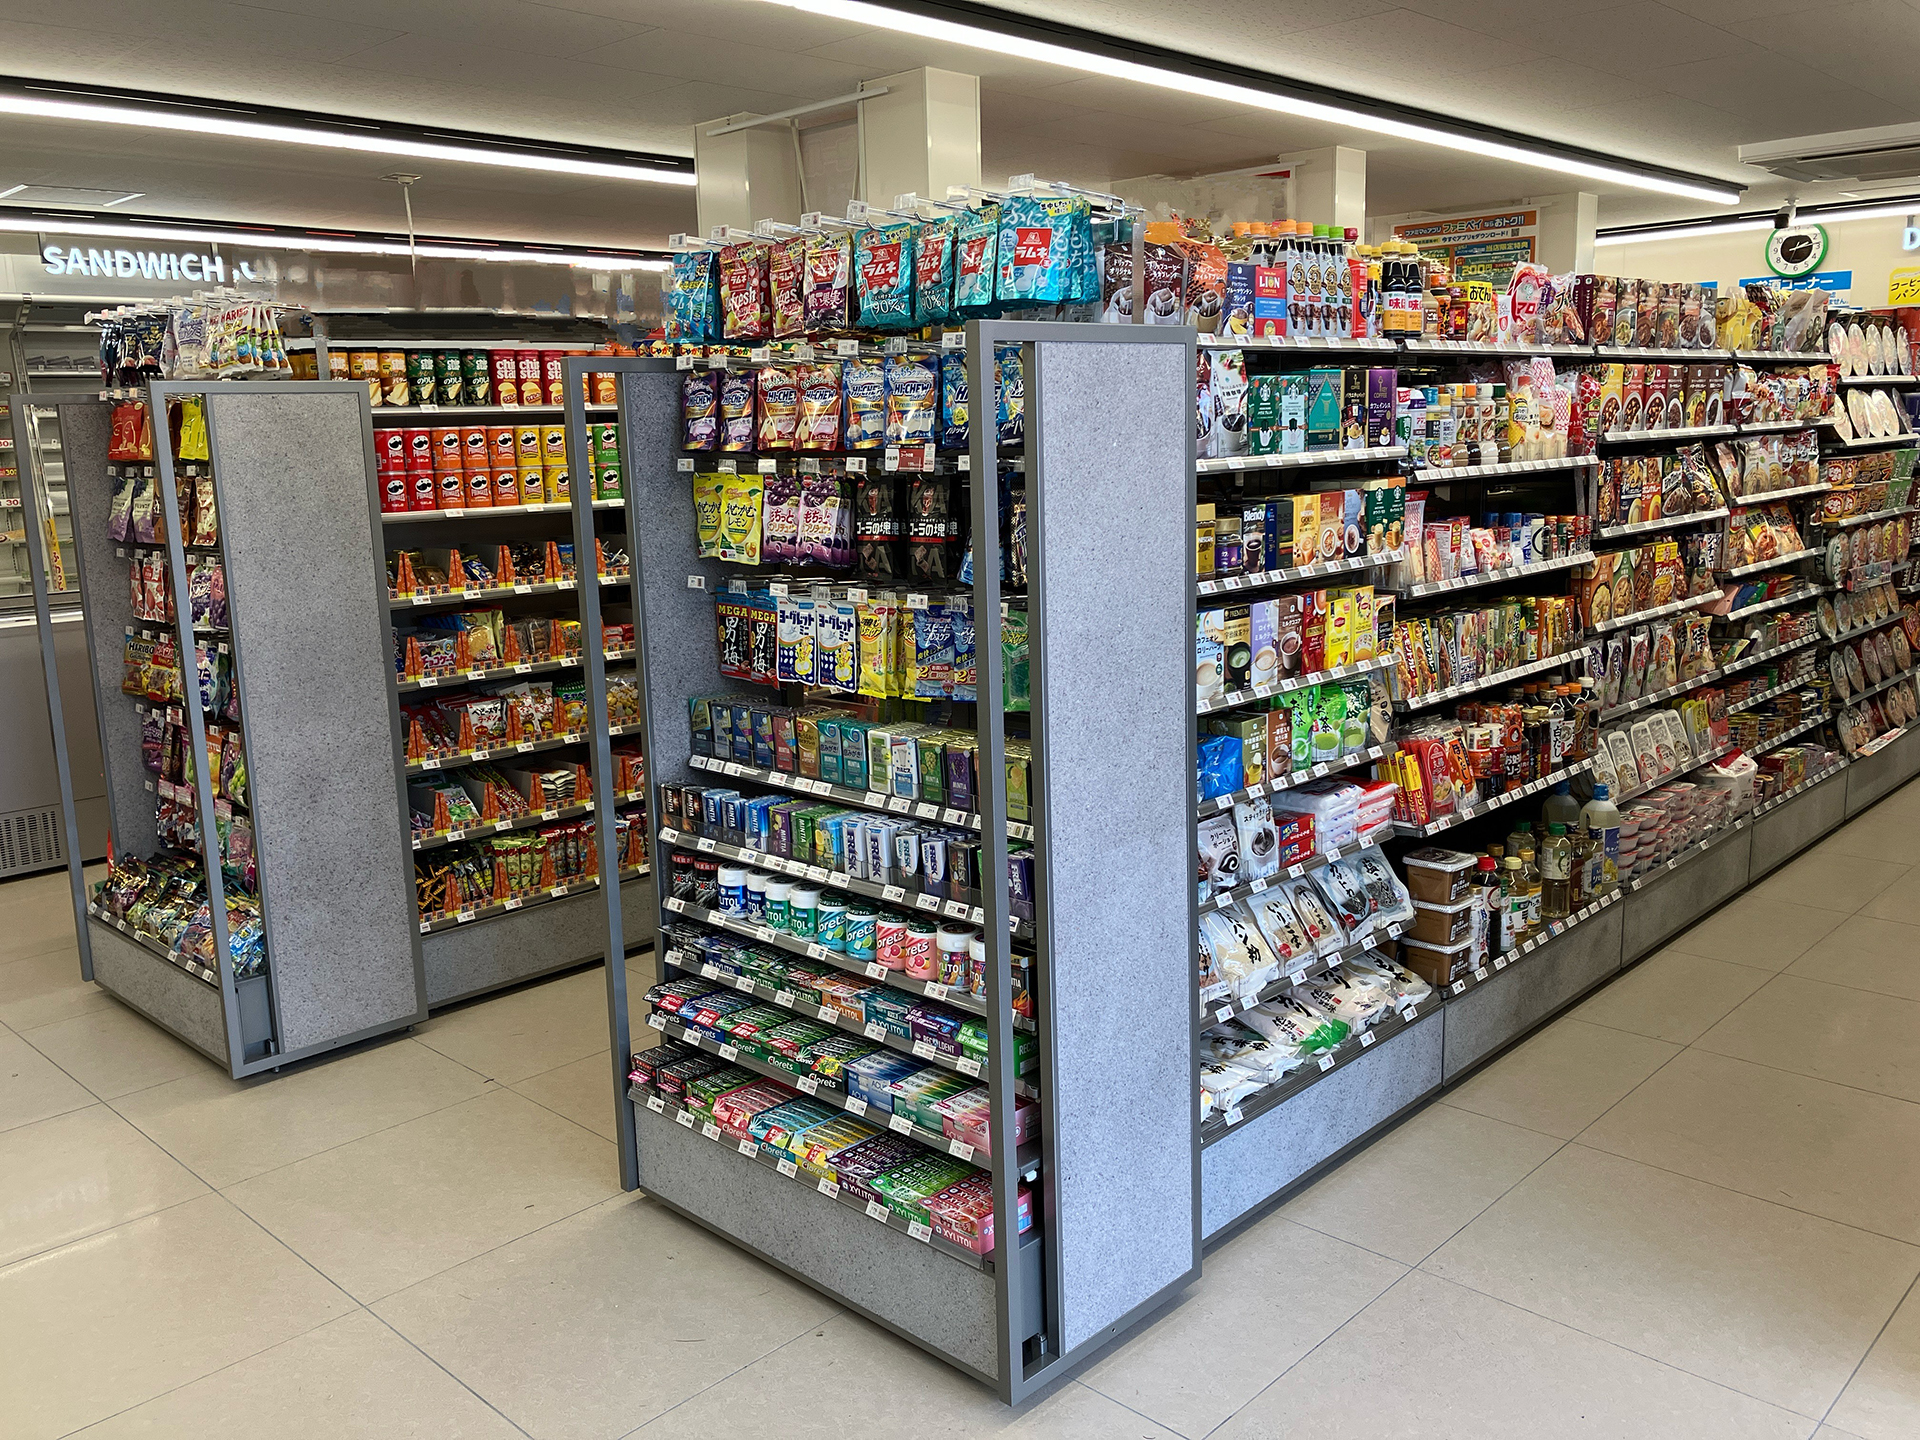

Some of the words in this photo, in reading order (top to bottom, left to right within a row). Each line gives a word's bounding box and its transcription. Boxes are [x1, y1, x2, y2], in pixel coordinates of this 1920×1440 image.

[1443, 219, 1482, 234] ファミペイ
[1015, 245, 1048, 259] ラムネ
[43, 245, 225, 283] SANDWICH
[864, 263, 897, 276] ラムネ
[1804, 261, 1810, 269] 5
[1258, 276, 1281, 289] LION
[1469, 285, 1490, 302] おでん
[893, 382, 932, 396] HI-CHEW
[728, 516, 747, 527] レモン
[1244, 510, 1266, 523] Blendy
[718, 604, 749, 618] MEGA
[750, 609, 777, 623] MEGA
[779, 610, 815, 627] ヨーグレット
[818, 613, 854, 629] ヨーグレット
[724, 616, 740, 666] 男梅
[753, 622, 768, 674] 男梅
[1421, 621, 1436, 674] バーモントカレー
[1400, 624, 1418, 679] バーモントカレー
[918, 666, 930, 679] 2
[956, 670, 969, 683] 2
[1552, 726, 1562, 760] 白だし
[666, 789, 674, 813] MINTIA
[687, 793, 695, 817] MINTIA
[1415, 790, 1427, 821] コンソメ
[707, 798, 716, 822] MINTIA
[728, 803, 736, 828] MINTIA
[751, 808, 759, 833] MINTIA
[799, 818, 807, 843] MINTIA
[1210, 828, 1232, 842] クリーミー
[1212, 835, 1235, 849] ポーション
[847, 829, 857, 873] FRISK
[870, 834, 882, 879] FRISK
[903, 839, 912, 869] FRISK
[929, 844, 939, 875] FRISK
[957, 852, 966, 883] FRISK
[1010, 864, 1023, 895] FRISK
[752, 975, 776, 990] XYLITOL
[656, 1010, 680, 1024] Clorets
[833, 1004, 860, 1021] XYLITOL
[692, 1025, 716, 1039] Clorets
[878, 1019, 906, 1038] XYLITOL
[730, 1039, 756, 1054] Clorets
[767, 1055, 794, 1071] Clorets
[808, 1072, 837, 1089] Clorets
[722, 1123, 748, 1139] Clorets
[760, 1142, 787, 1159] Clorets
[801, 1161, 829, 1178] Clorets
[943, 1228, 974, 1250] XYLITOL
